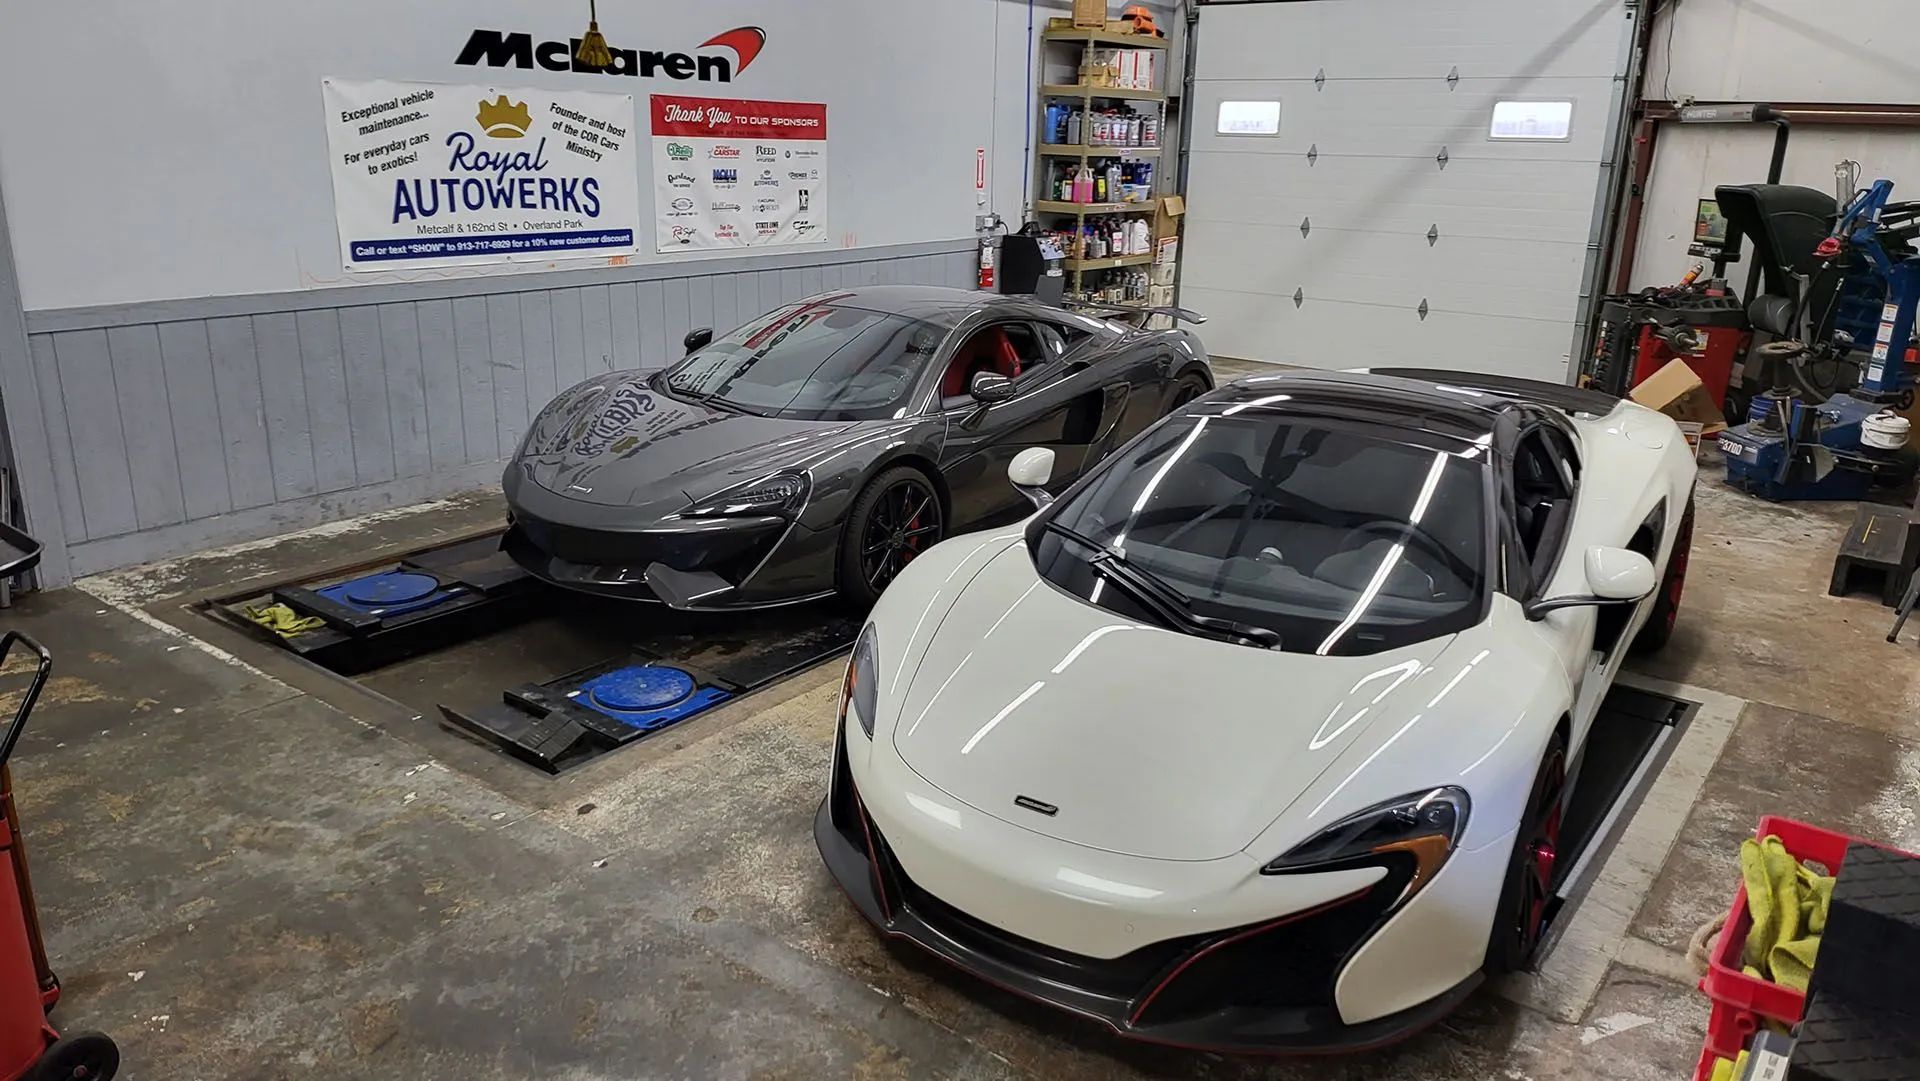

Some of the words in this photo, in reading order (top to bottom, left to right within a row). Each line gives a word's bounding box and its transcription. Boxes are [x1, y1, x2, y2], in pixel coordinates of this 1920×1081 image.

[341, 97, 399, 122] Exceptional
[401, 90, 434, 107] vehicle
[664, 104, 703, 123] Thank
[706, 106, 731, 129] You
[735, 115, 748, 125] TO
[749, 116, 769, 126] OUR
[771, 117, 819, 127] SPONSORS
[359, 110, 429, 135] maintenance...
[549, 102, 587, 123] Founder
[588, 118, 606, 130] and
[607, 123, 626, 138] host
[344, 153, 360, 164] For
[363, 139, 407, 159] everyday
[409, 133, 430, 146] cars
[552, 121, 563, 131] of
[564, 124, 578, 136] the
[580, 130, 599, 143] COR
[600, 137, 619, 151] Cars
[368, 164, 378, 175] to
[381, 151, 418, 172] exotics!
[446, 132, 549, 186] Royal
[565, 140, 602, 162] Ministry
[392, 177, 600, 224] AUTOWERKS
[417, 224, 454, 235] Metcalf
[457, 223, 464, 233] &
[466, 222, 496, 233] 162nd
[499, 221, 508, 231] St
[522, 220, 562, 231] Overland
[564, 219, 583, 228] Park
[356, 246, 375, 256] Call
[376, 247, 387, 255] or
[388, 245, 406, 254] text
[446, 243, 456, 251] to
[512, 239, 523, 248] for
[531, 238, 548, 247] 10%
[566, 236, 600, 245] customer
[600, 234, 630, 243] discount
